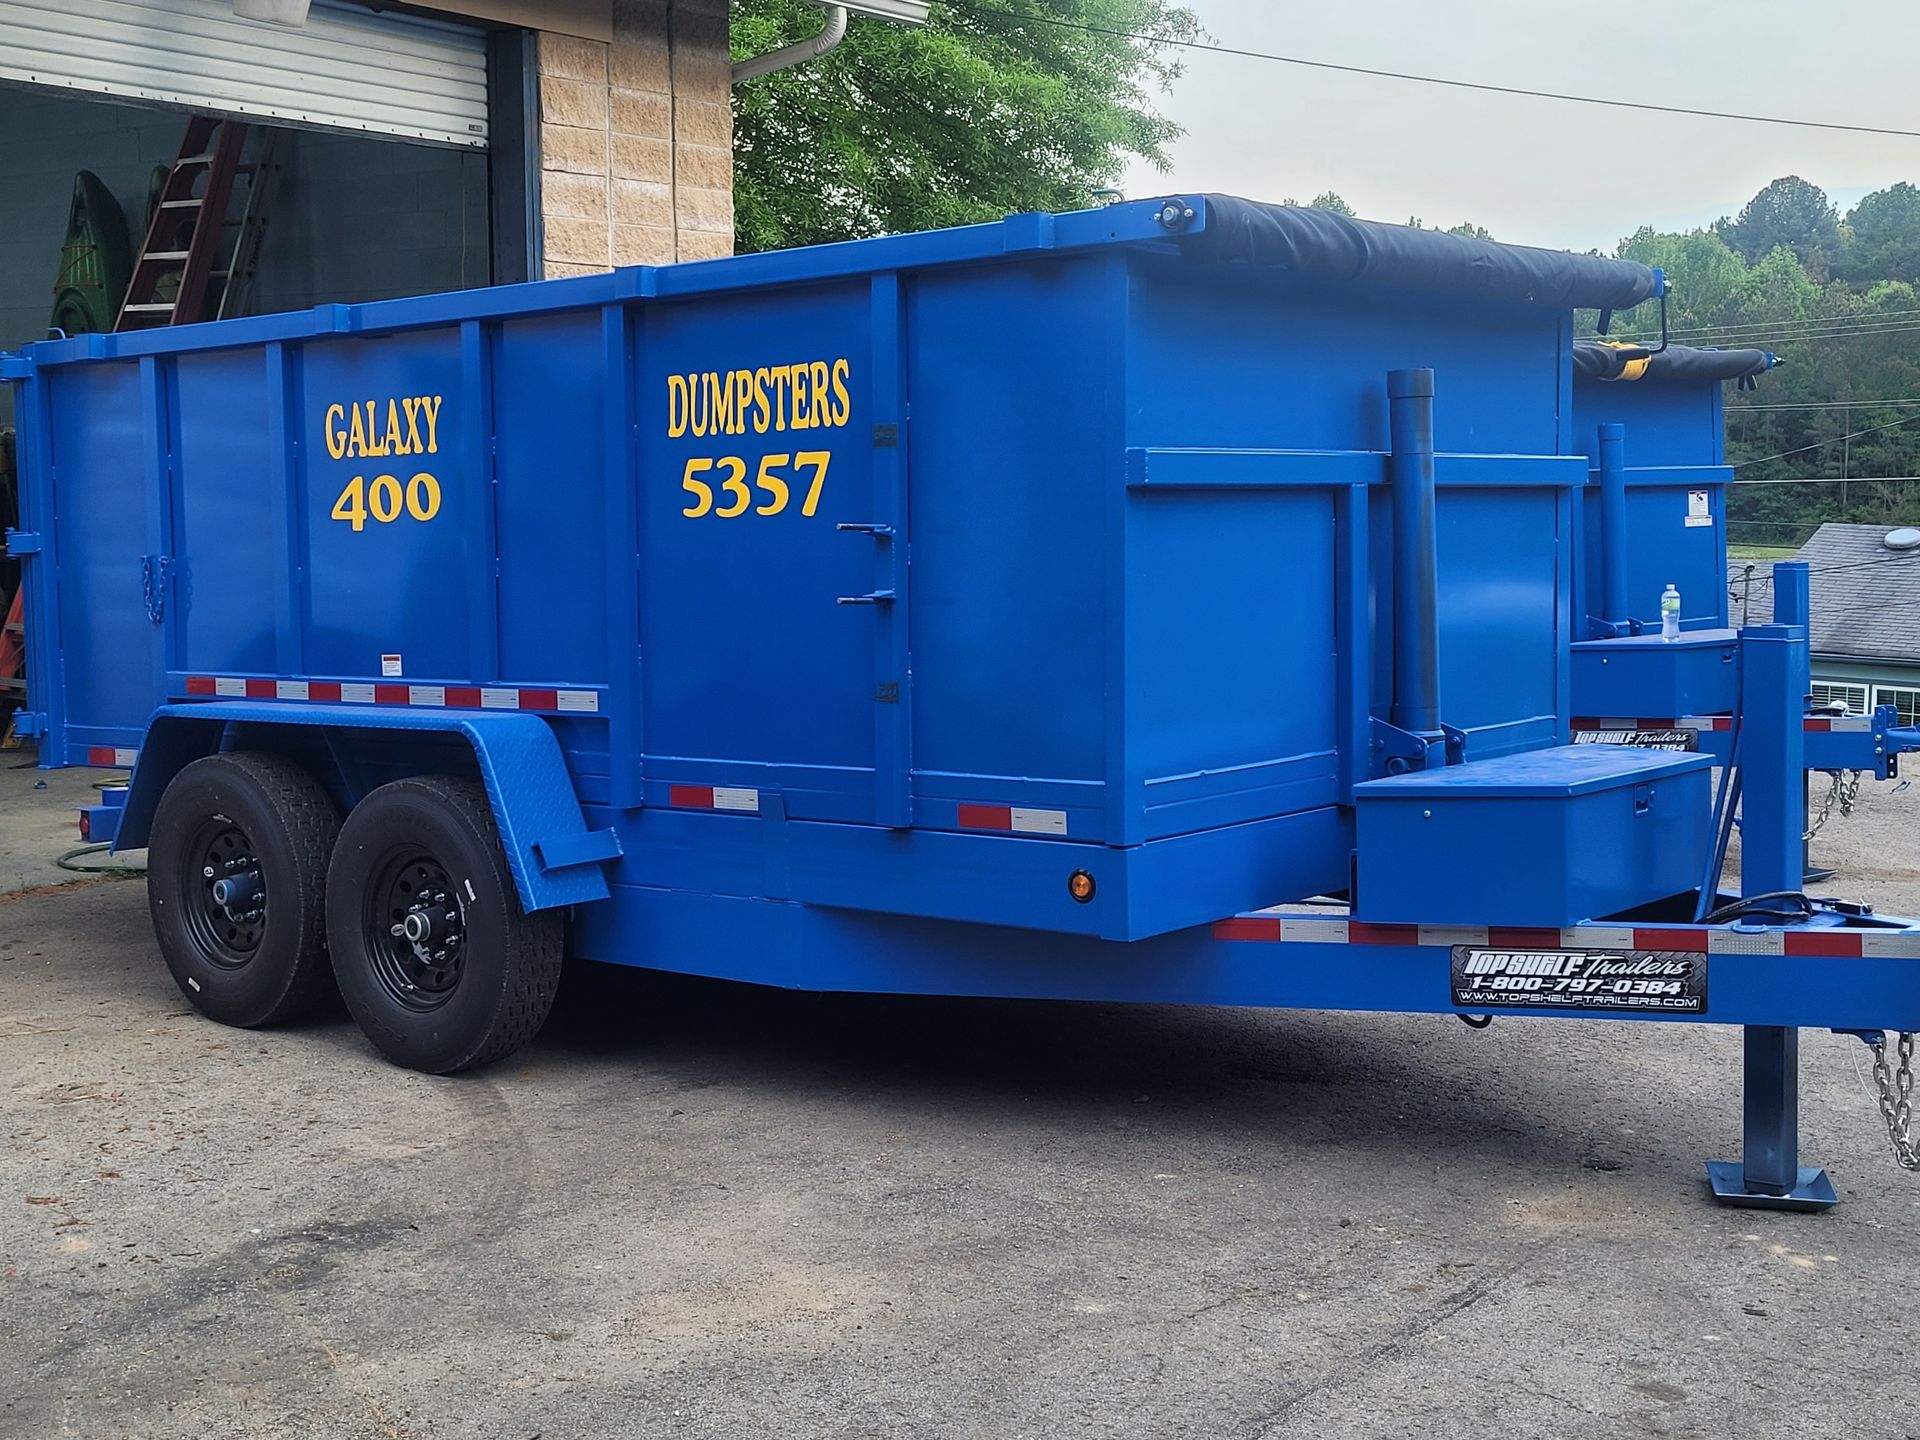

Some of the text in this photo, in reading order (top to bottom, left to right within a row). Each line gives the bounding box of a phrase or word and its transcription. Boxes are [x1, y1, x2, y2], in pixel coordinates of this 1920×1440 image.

[325, 358, 850, 460] GALAXY DUMPSTERS
[331, 451, 831, 531] 400 5357
[1635, 731, 1689, 744] Trailers
[1463, 950, 1690, 978] TOPSHELF Trailers
[1471, 976, 1682, 995] 1-800-797-0384
[1460, 991, 1698, 1007] WWW.TOPSHELFTRAILERS.COM
